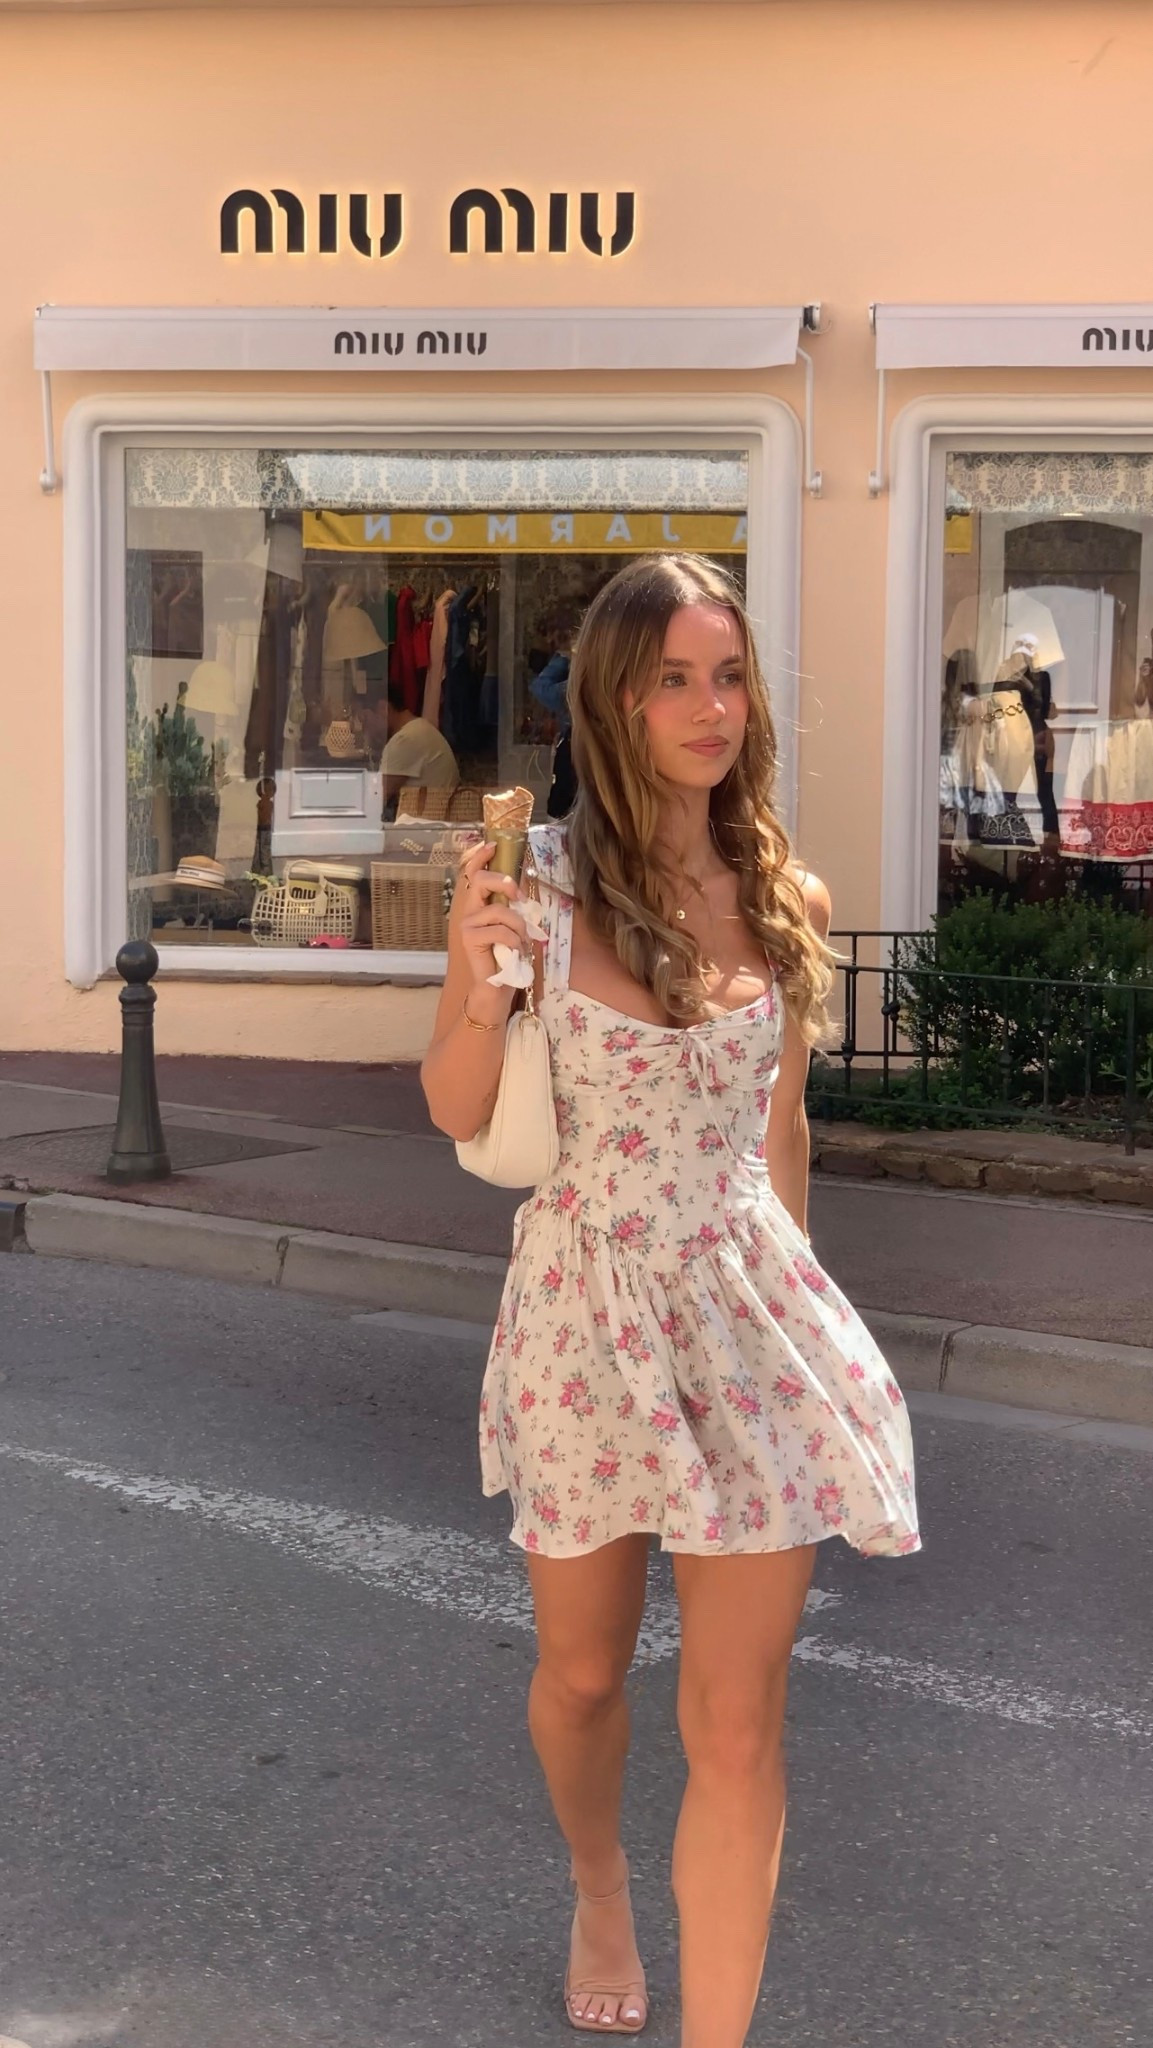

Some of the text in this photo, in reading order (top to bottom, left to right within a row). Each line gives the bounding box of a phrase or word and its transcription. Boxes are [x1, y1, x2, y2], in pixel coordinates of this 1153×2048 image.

[220, 187, 635, 258] MIU MIU
[334, 331, 487, 356] MIU MIU
[1082, 327, 1153, 352] MIU
